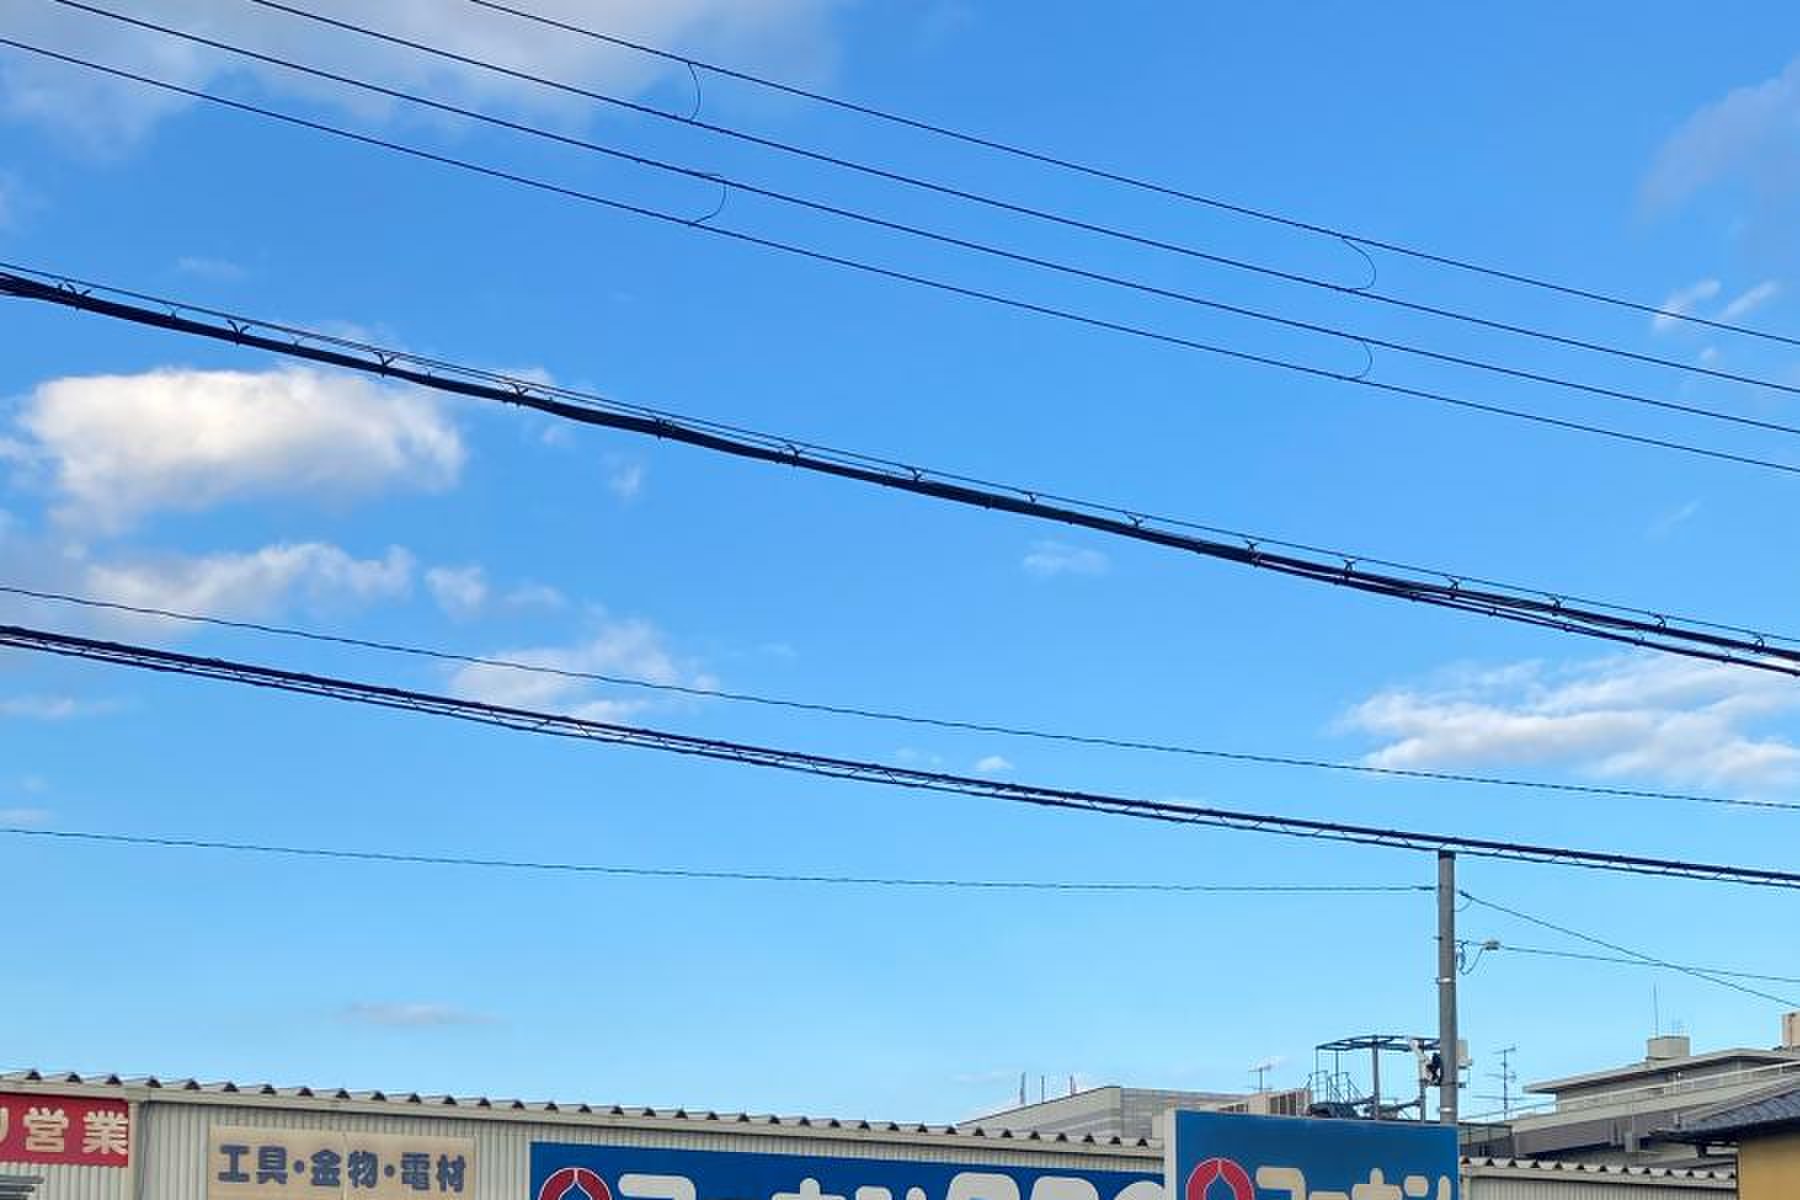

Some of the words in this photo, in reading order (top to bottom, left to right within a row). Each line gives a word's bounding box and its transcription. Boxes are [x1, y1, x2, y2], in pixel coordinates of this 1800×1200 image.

[217, 1143, 467, 1193] 工具・金物・電材
